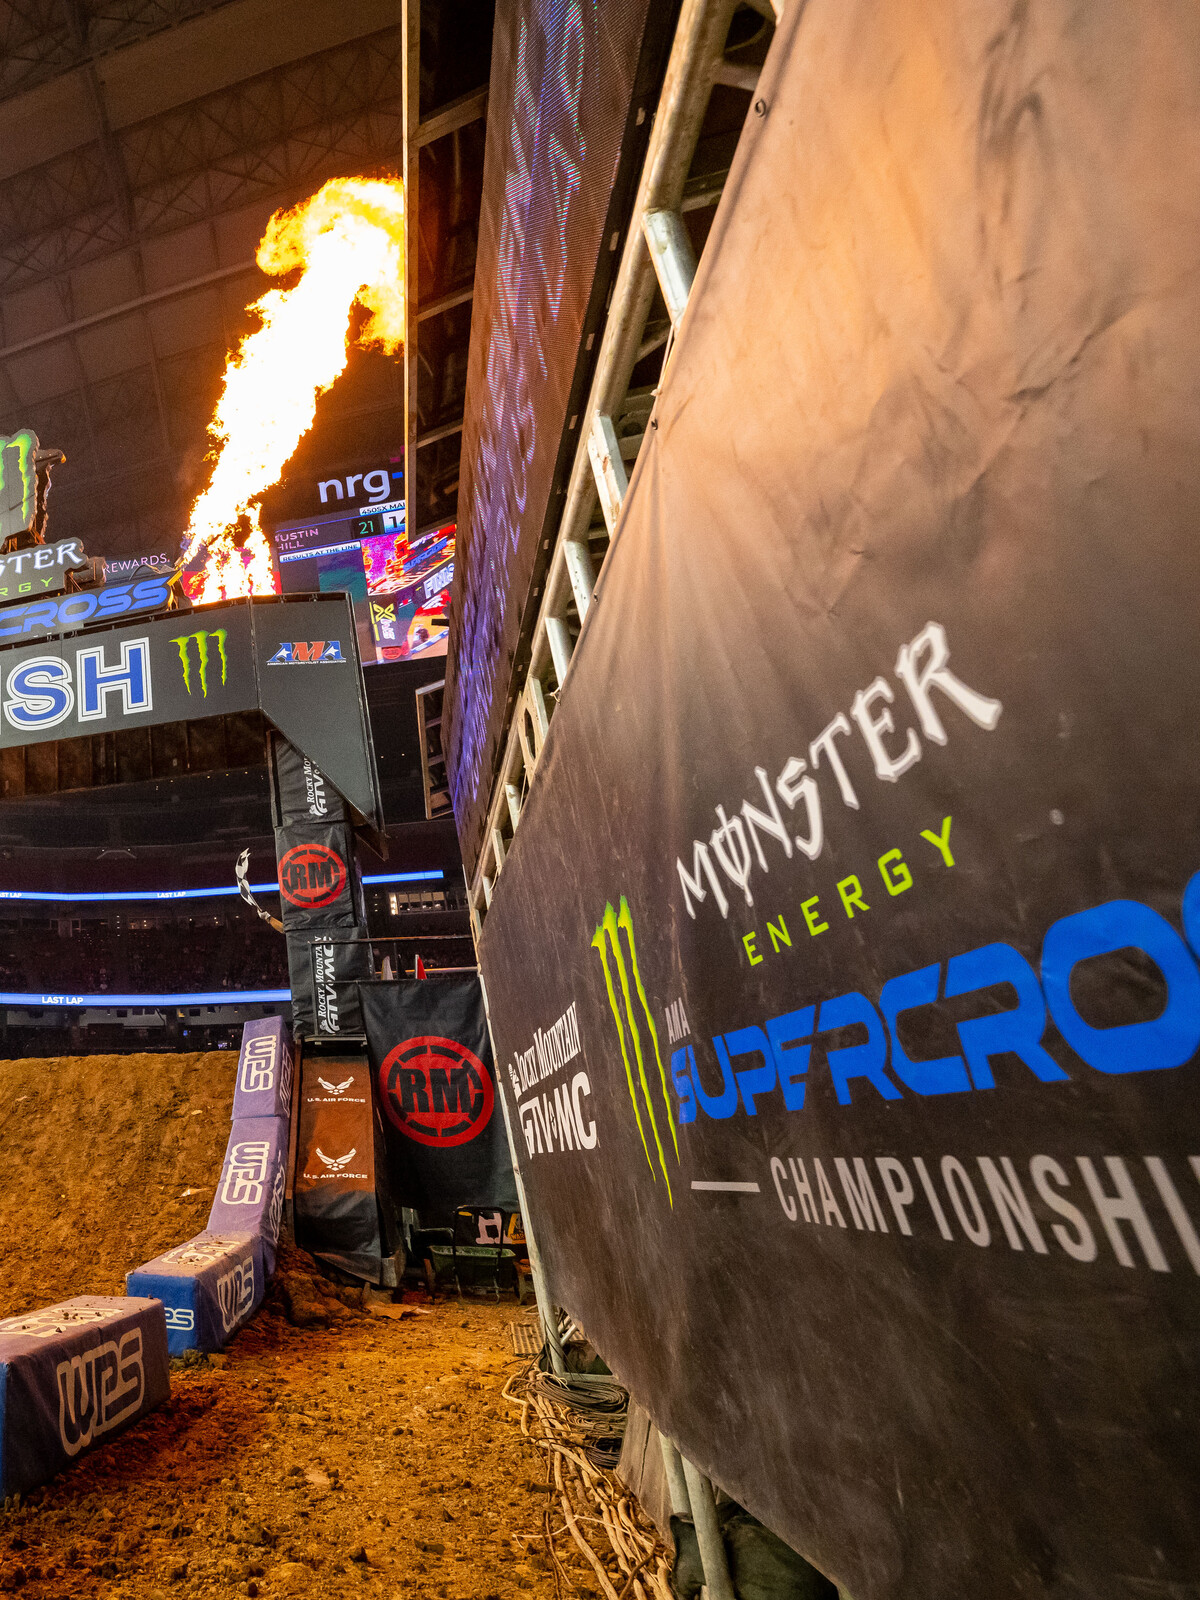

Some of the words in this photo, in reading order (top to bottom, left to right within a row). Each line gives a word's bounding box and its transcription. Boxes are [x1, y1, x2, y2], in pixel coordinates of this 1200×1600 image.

[317, 469, 391, 504] nrg
[358, 520, 374, 535] 21
[282, 551, 315, 562] RESULTS
[341, 544, 359, 552] LINE
[266, 640, 346, 662] AMA
[306, 777, 316, 804] ROCKY
[742, 816, 956, 966] ENERGY
[41, 995, 64, 1005] LAST
[64, 996, 84, 1005] LAP
[318, 987, 327, 1018] ROCKY
[664, 997, 691, 1044] AMA
[671, 870, 1200, 1125] SUPERCRO
[240, 1034, 277, 1093] WPS
[533, 1000, 582, 1080] MOUNTAIN
[220, 1141, 270, 1205] WPS
[770, 1154, 1200, 1277] CHAMPIONSHI
[216, 1255, 255, 1334] WPS
[164, 1307, 195, 1331] PS
[56, 1326, 145, 1456] WPS
